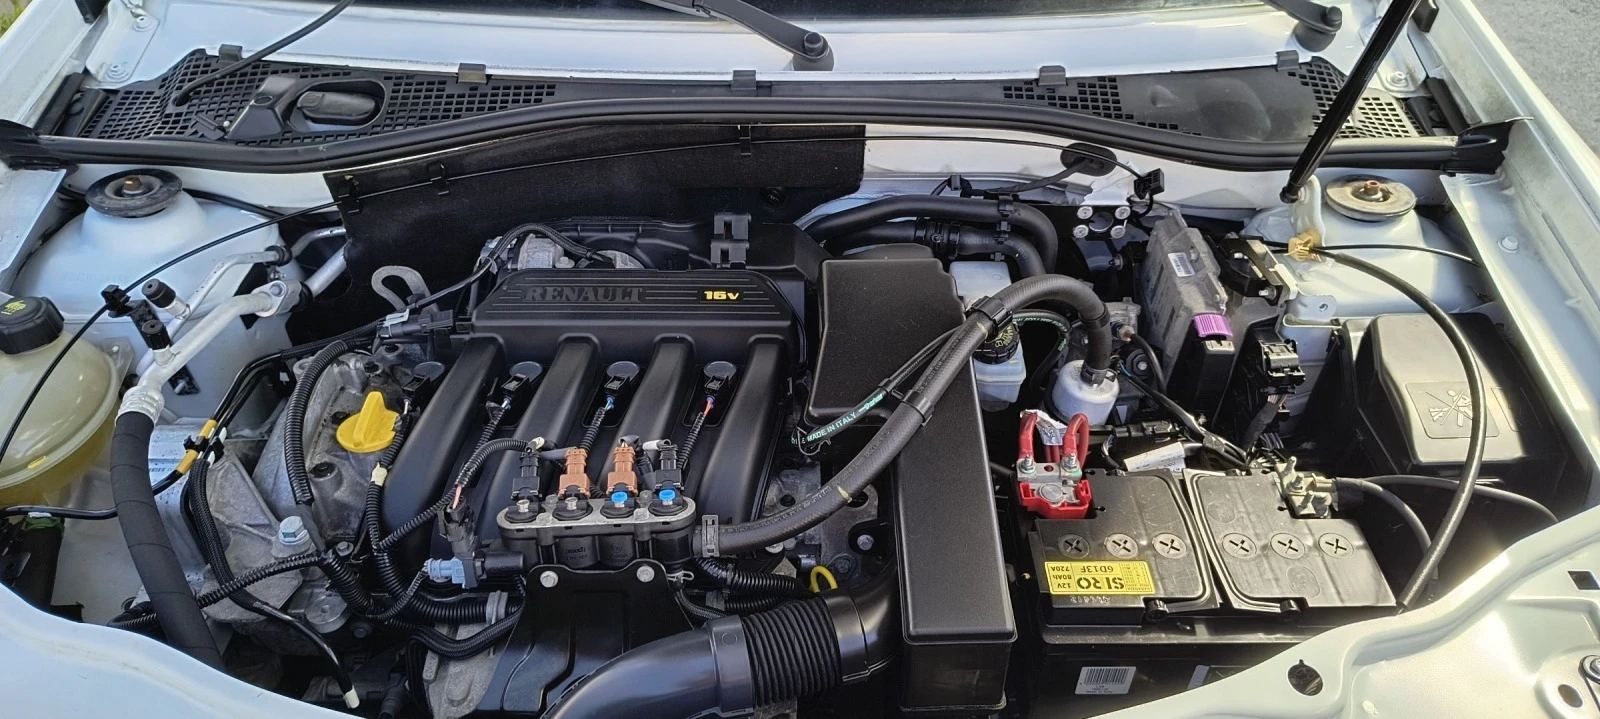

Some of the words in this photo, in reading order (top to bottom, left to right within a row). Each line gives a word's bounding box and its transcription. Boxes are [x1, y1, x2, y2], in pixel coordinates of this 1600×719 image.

[524, 286, 642, 302] RENAULT
[807, 428, 827, 441] MADE
[828, 424, 835, 433] IN
[836, 412, 856, 428] ITALY
[1080, 565, 1114, 573] 6D13F
